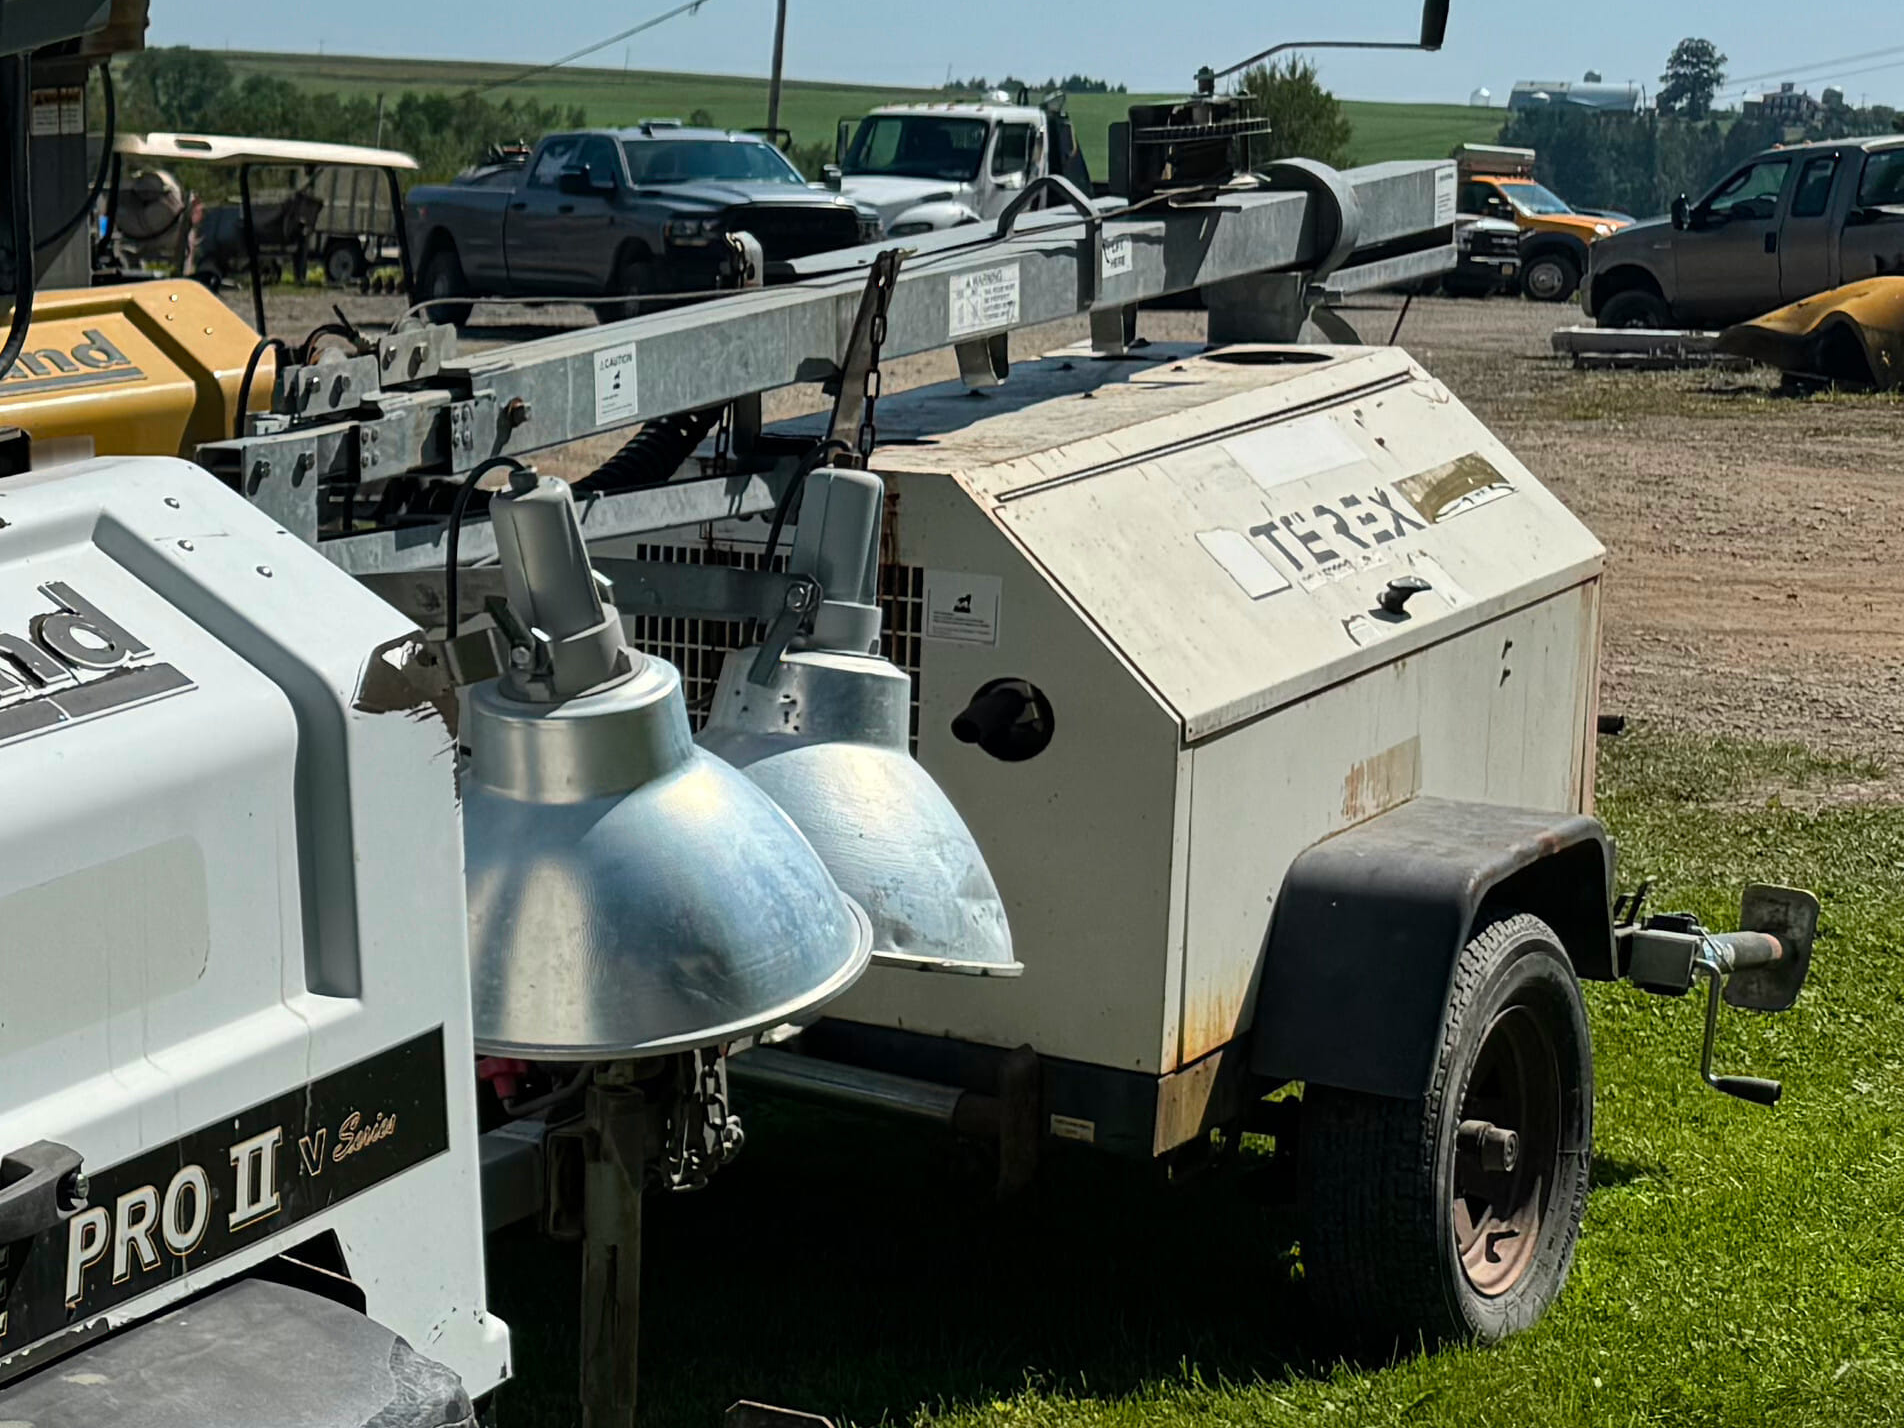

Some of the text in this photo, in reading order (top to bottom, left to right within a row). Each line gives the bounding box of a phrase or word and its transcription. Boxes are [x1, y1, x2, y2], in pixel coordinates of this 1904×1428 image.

[65, 1163, 211, 1311] PRO
[228, 1125, 284, 1233] II
[298, 1127, 327, 1176] V
[333, 1111, 396, 1162] Series
